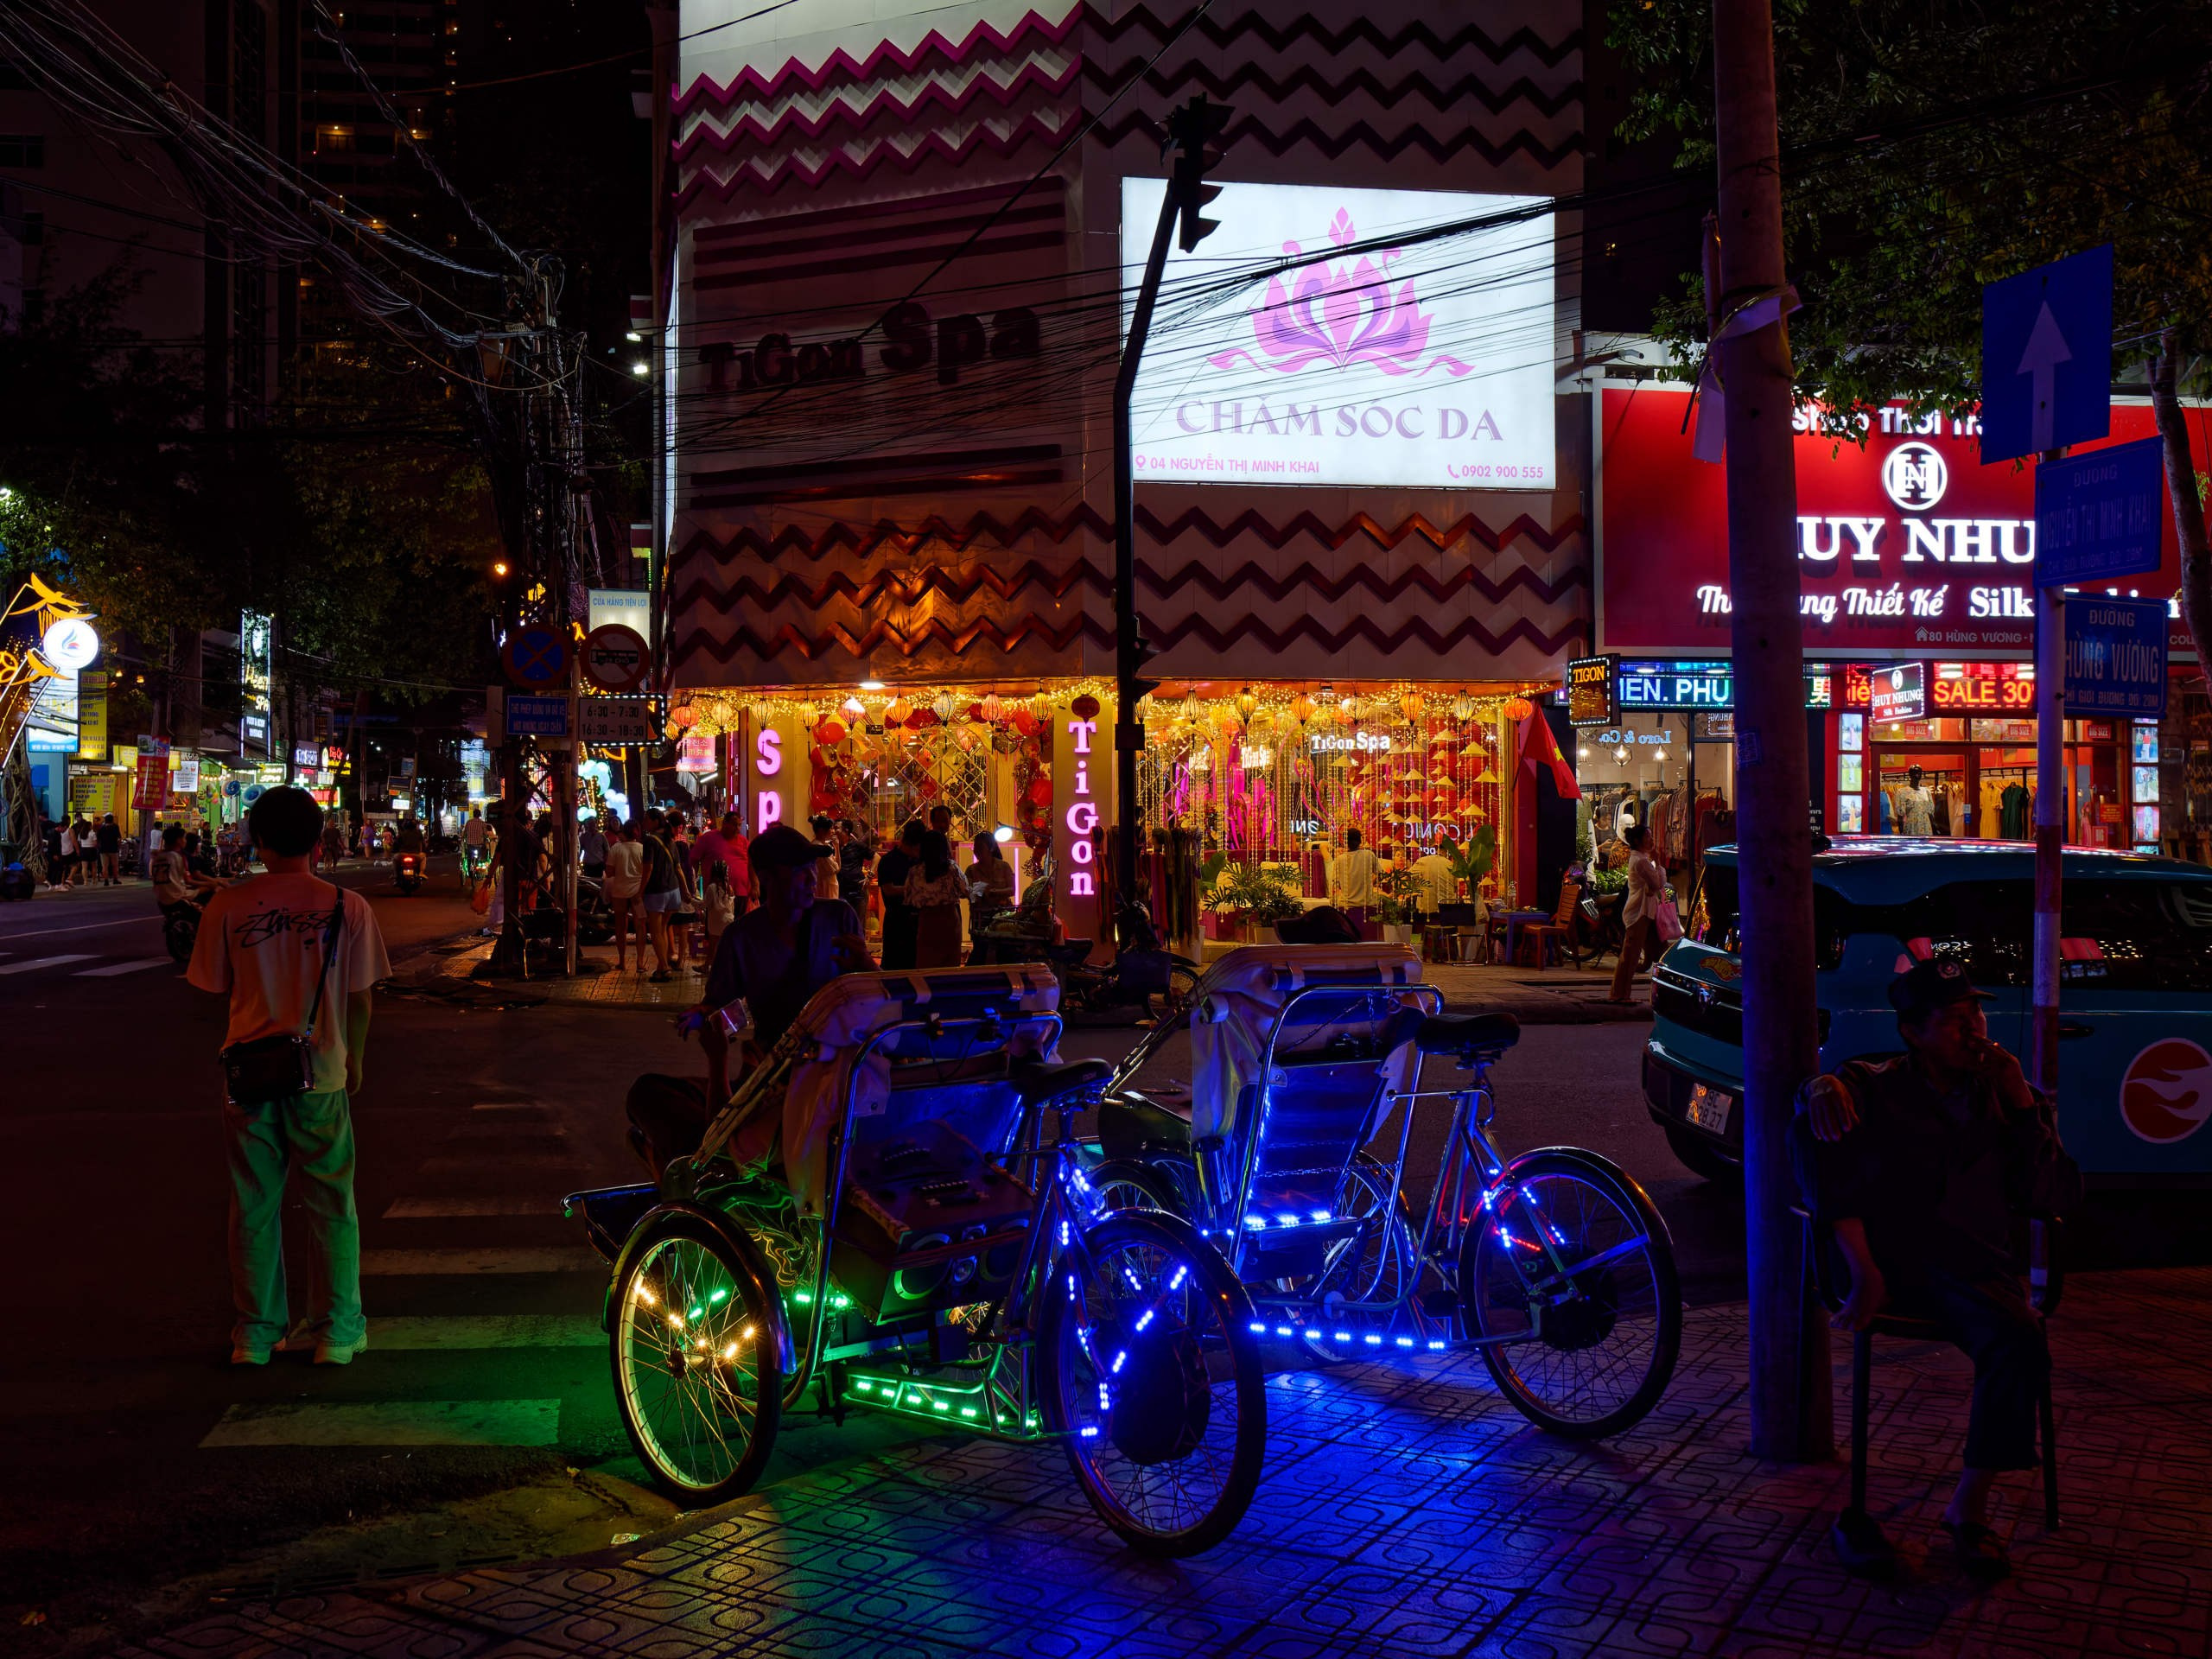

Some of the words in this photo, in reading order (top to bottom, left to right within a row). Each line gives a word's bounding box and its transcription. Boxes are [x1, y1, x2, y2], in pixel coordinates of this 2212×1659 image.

[880, 301, 1039, 385] Spa
[1176, 394, 1324, 436] CHĂM
[1334, 397, 1425, 440] SÓC
[1437, 408, 1504, 441] DA
[1150, 457, 1165, 469] 04
[1170, 453, 1224, 471] NGUYỄN
[1228, 459, 1248, 474] THỊ
[1252, 460, 1285, 473] MINH
[1289, 461, 1319, 474] KHAI
[1461, 464, 1491, 478] 0902
[1496, 465, 1518, 479] 900
[1522, 467, 1543, 479] 555
[1796, 516, 1885, 561] UY
[1842, 582, 1906, 616] Thiết
[1909, 584, 1949, 617] Kế
[1969, 586, 2035, 618] Silk
[1929, 632, 1942, 642] 80
[1946, 628, 1978, 643] HÙNG
[1981, 630, 2022, 643] VƯƠNG
[2111, 639, 2161, 684] VƯƠNG
[1573, 665, 1605, 683] TIGON
[1874, 694, 1891, 708] HUY
[1891, 689, 1922, 704] NHUNG
[1934, 681, 1996, 703] SALE
[2002, 680, 2034, 703] 30
[587, 706, 608, 717] 6:30
[619, 707, 639, 718] 7:30
[582, 724, 607, 735] 16:30
[1311, 734, 1355, 750] TiGon
[1356, 730, 1391, 754] Spa
[1066, 721, 1099, 895] TiGon
